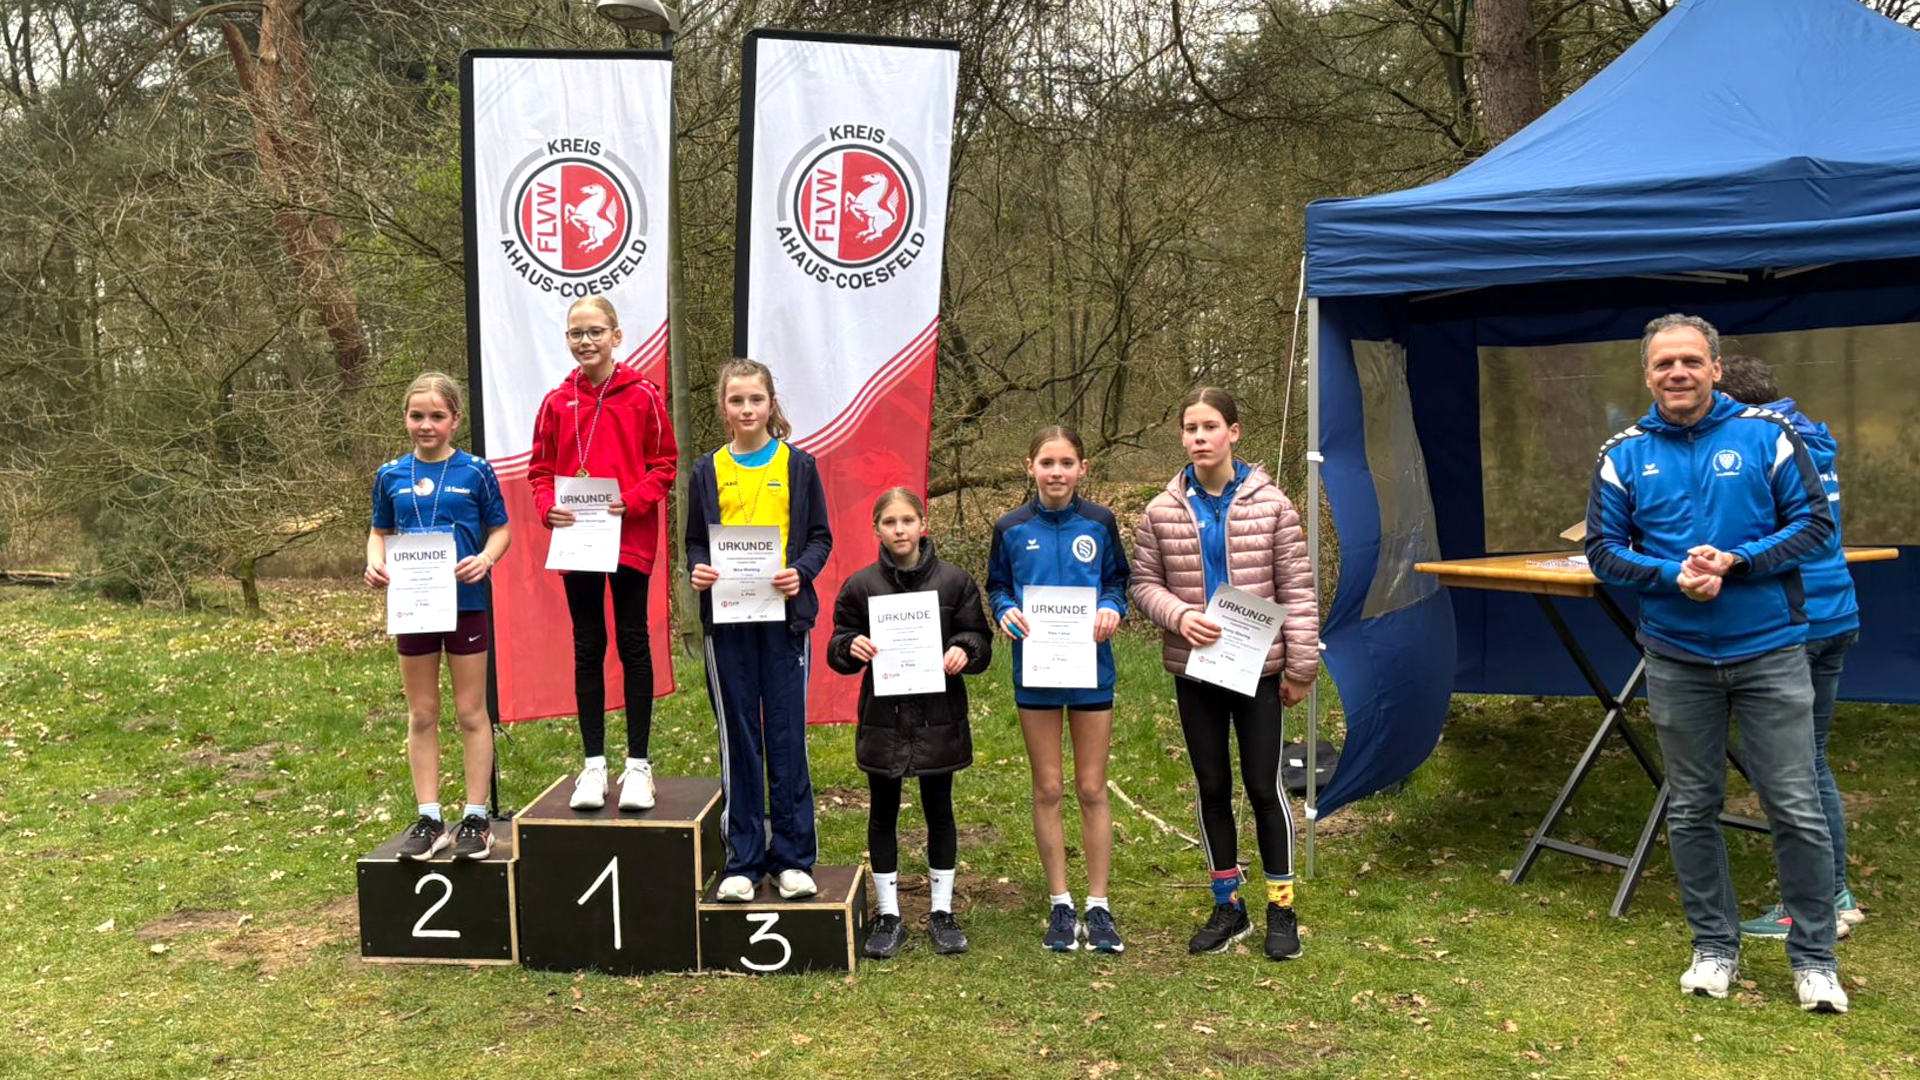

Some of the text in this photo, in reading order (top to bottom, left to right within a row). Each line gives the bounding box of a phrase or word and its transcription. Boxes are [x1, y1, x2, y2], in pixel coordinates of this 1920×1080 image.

[547, 138, 601, 156] KREIS
[829, 124, 886, 144] KREIS
[536, 182, 558, 253] FLVW
[814, 168, 838, 242] FLVW
[501, 239, 647, 298] AHAUS-COESFELD
[776, 226, 925, 290] AHAUS-COESFELD
[560, 493, 613, 504] URKUNDE
[393, 550, 447, 562] URKUNDE
[718, 541, 774, 551] URKUNDE
[877, 610, 932, 623] URKUNDE
[1031, 604, 1088, 615] URKUNDE
[1218, 598, 1275, 626] URKUNDE
[412, 873, 461, 938] 2
[577, 855, 621, 950] 1
[740, 912, 792, 971] 3
